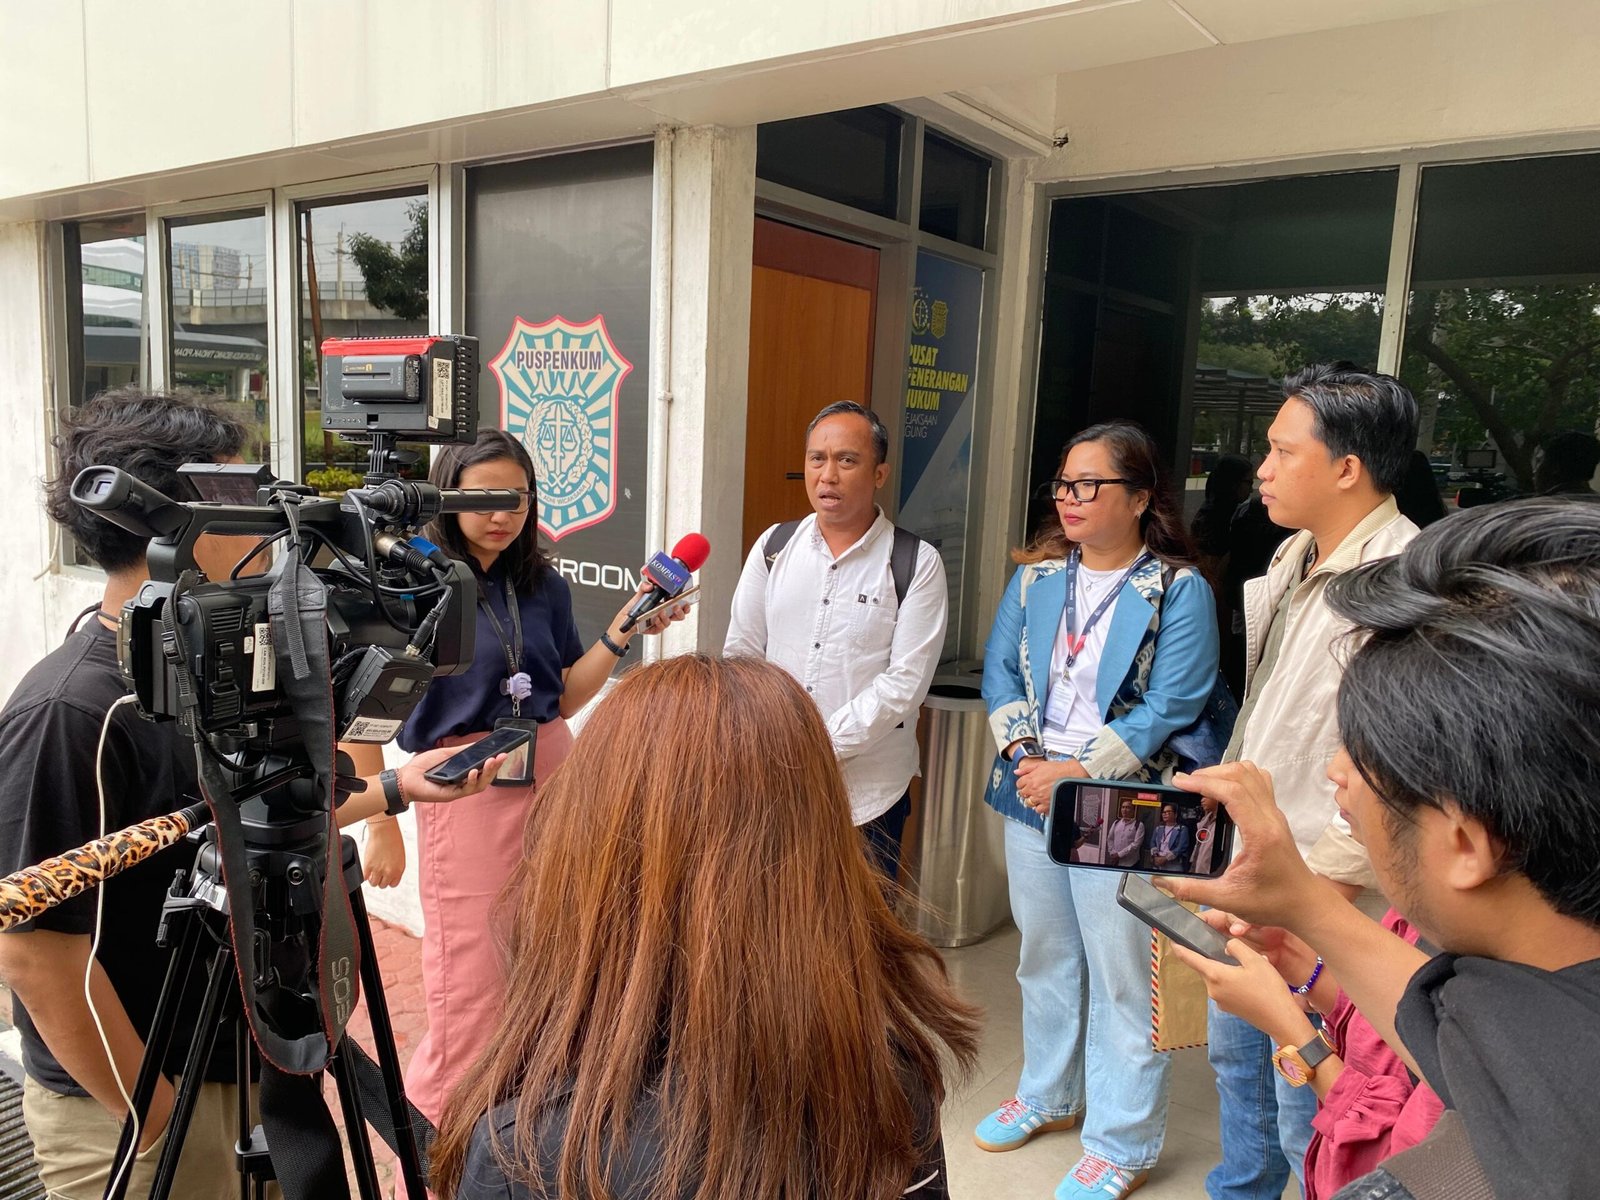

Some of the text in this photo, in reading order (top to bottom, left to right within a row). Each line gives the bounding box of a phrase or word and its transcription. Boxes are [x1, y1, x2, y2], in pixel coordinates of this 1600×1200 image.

[516, 350, 602, 371] PUSPENKUM
[905, 412, 937, 425] EJAKSAAN
[905, 425, 928, 438] GUNG
[331, 957, 350, 1025] EOS
